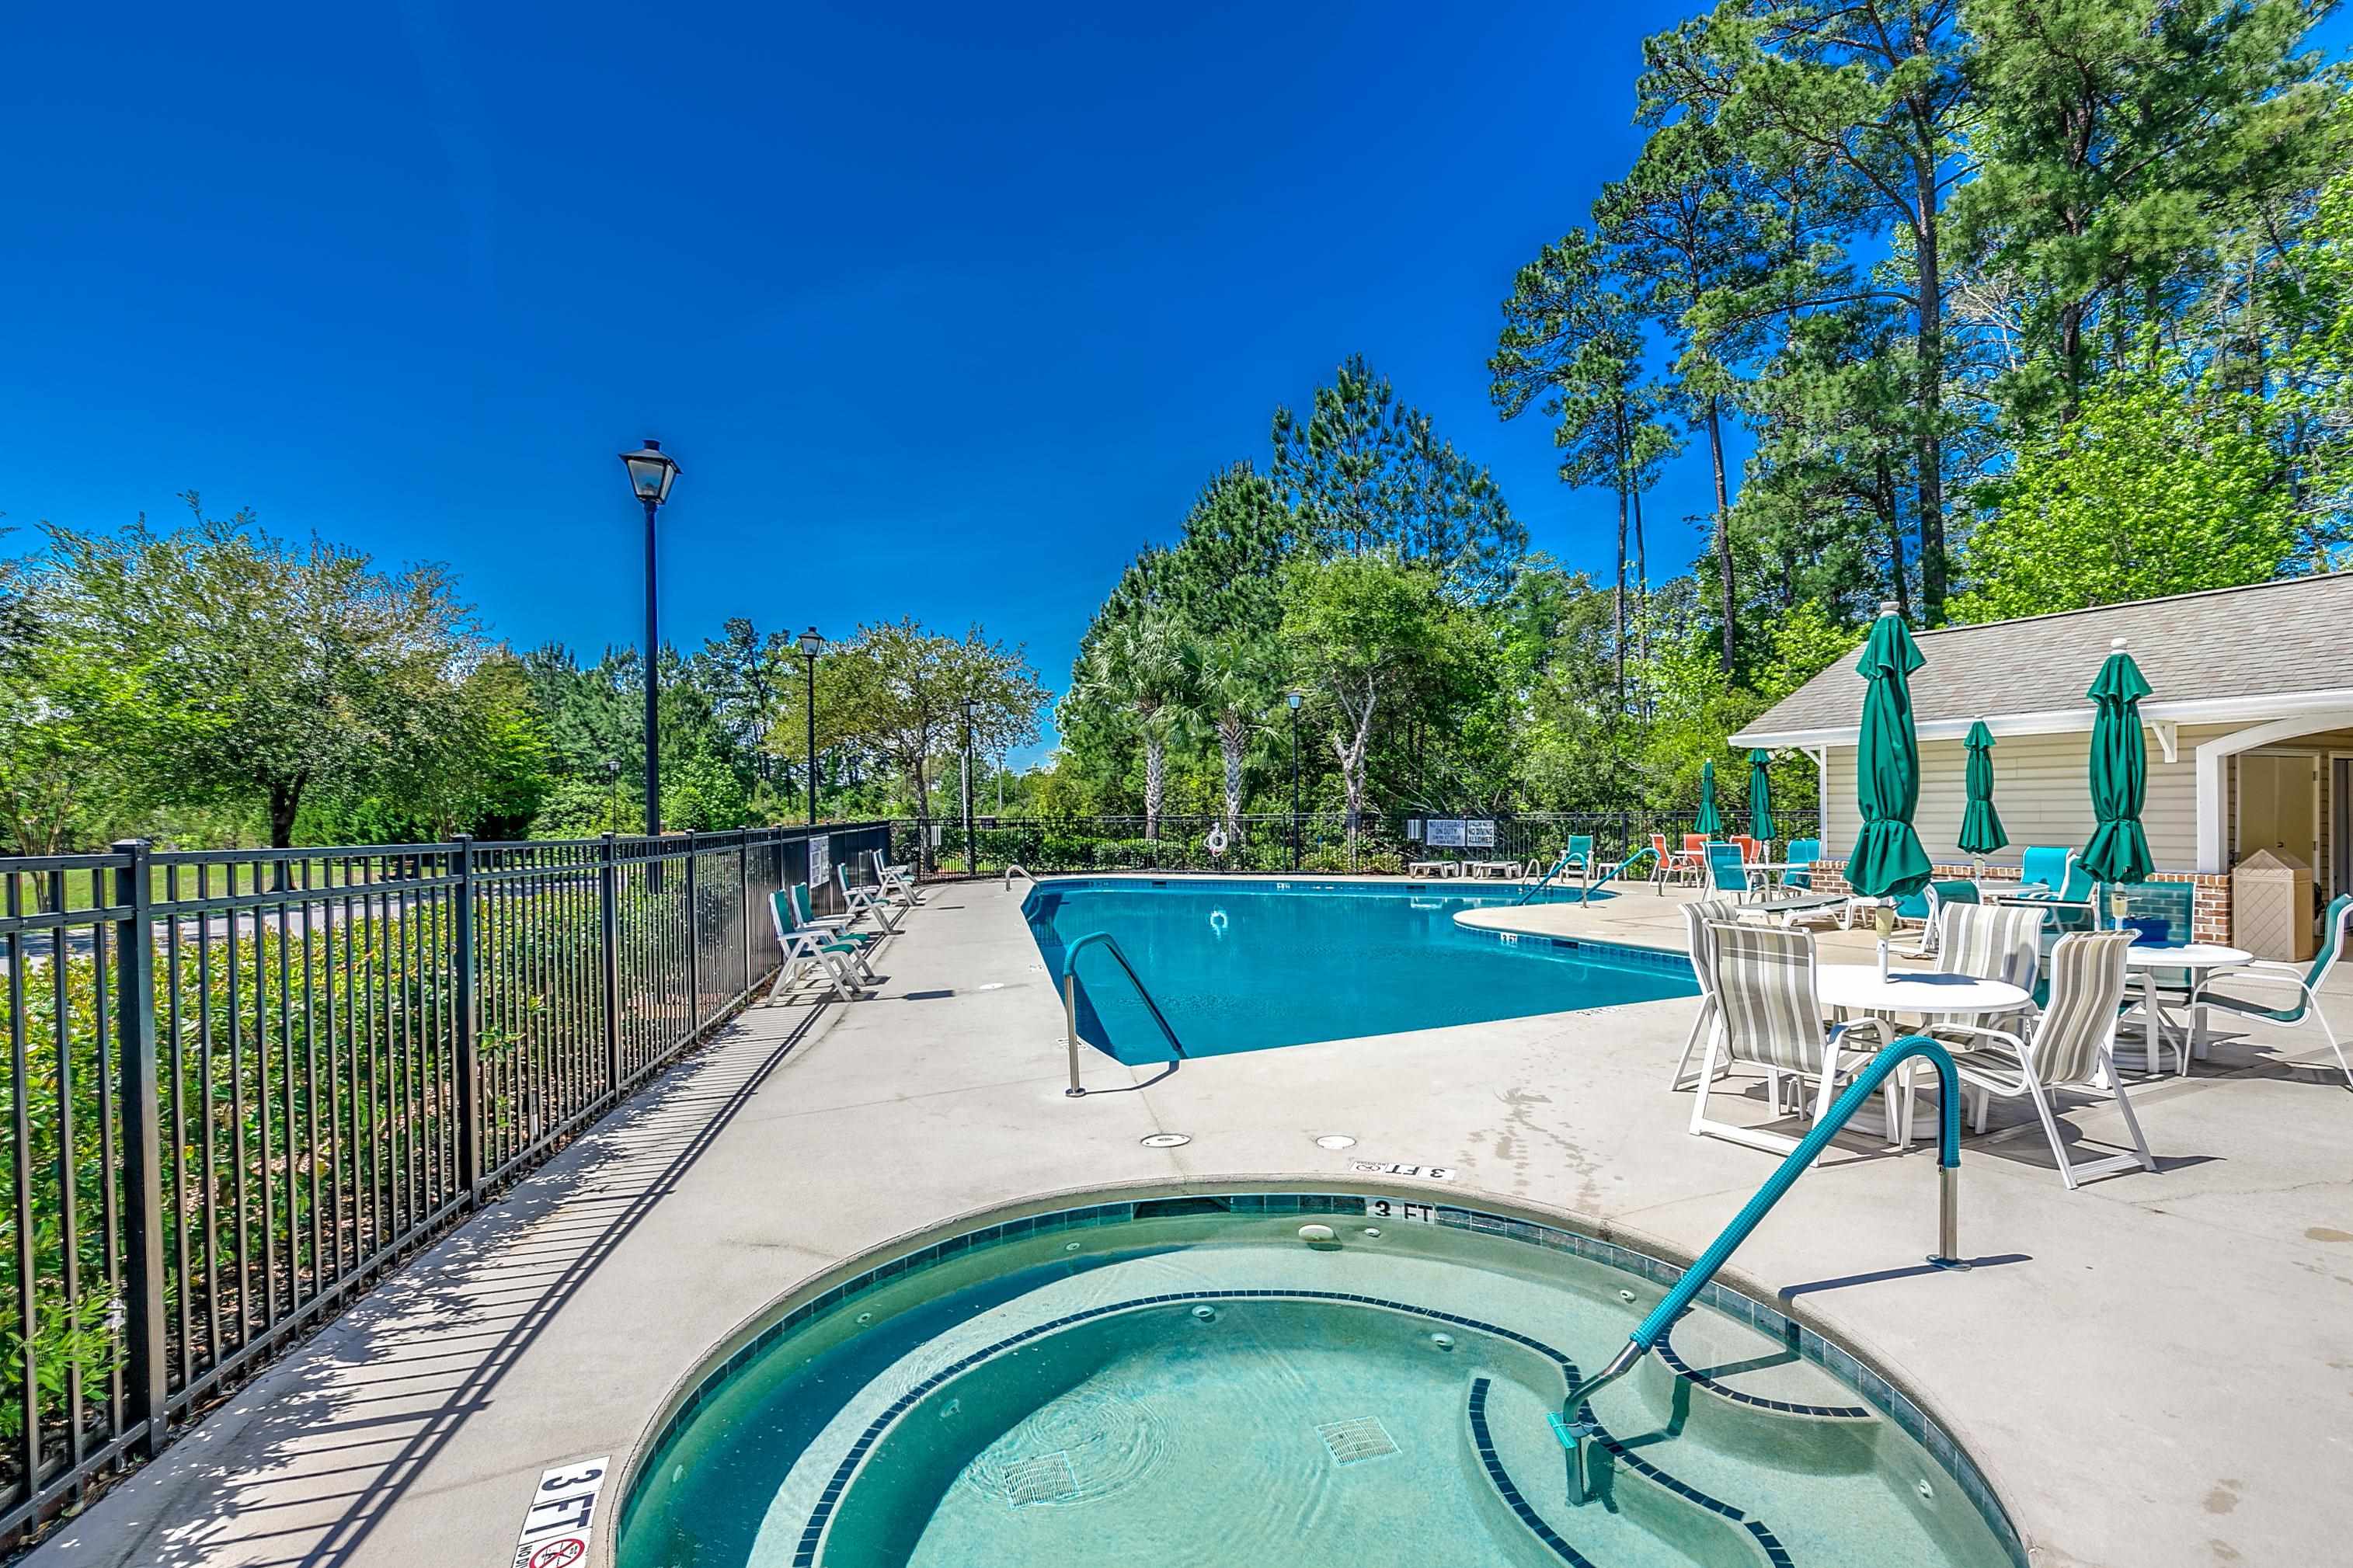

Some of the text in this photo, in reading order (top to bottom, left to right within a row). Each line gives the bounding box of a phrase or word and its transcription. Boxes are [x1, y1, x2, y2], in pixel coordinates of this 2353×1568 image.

[1385, 1164, 1446, 1178] 3 FT
[1375, 1201, 1433, 1222] 3 FT
[524, 1469, 603, 1535] 3 FT
[517, 1545, 532, 1557] NO
